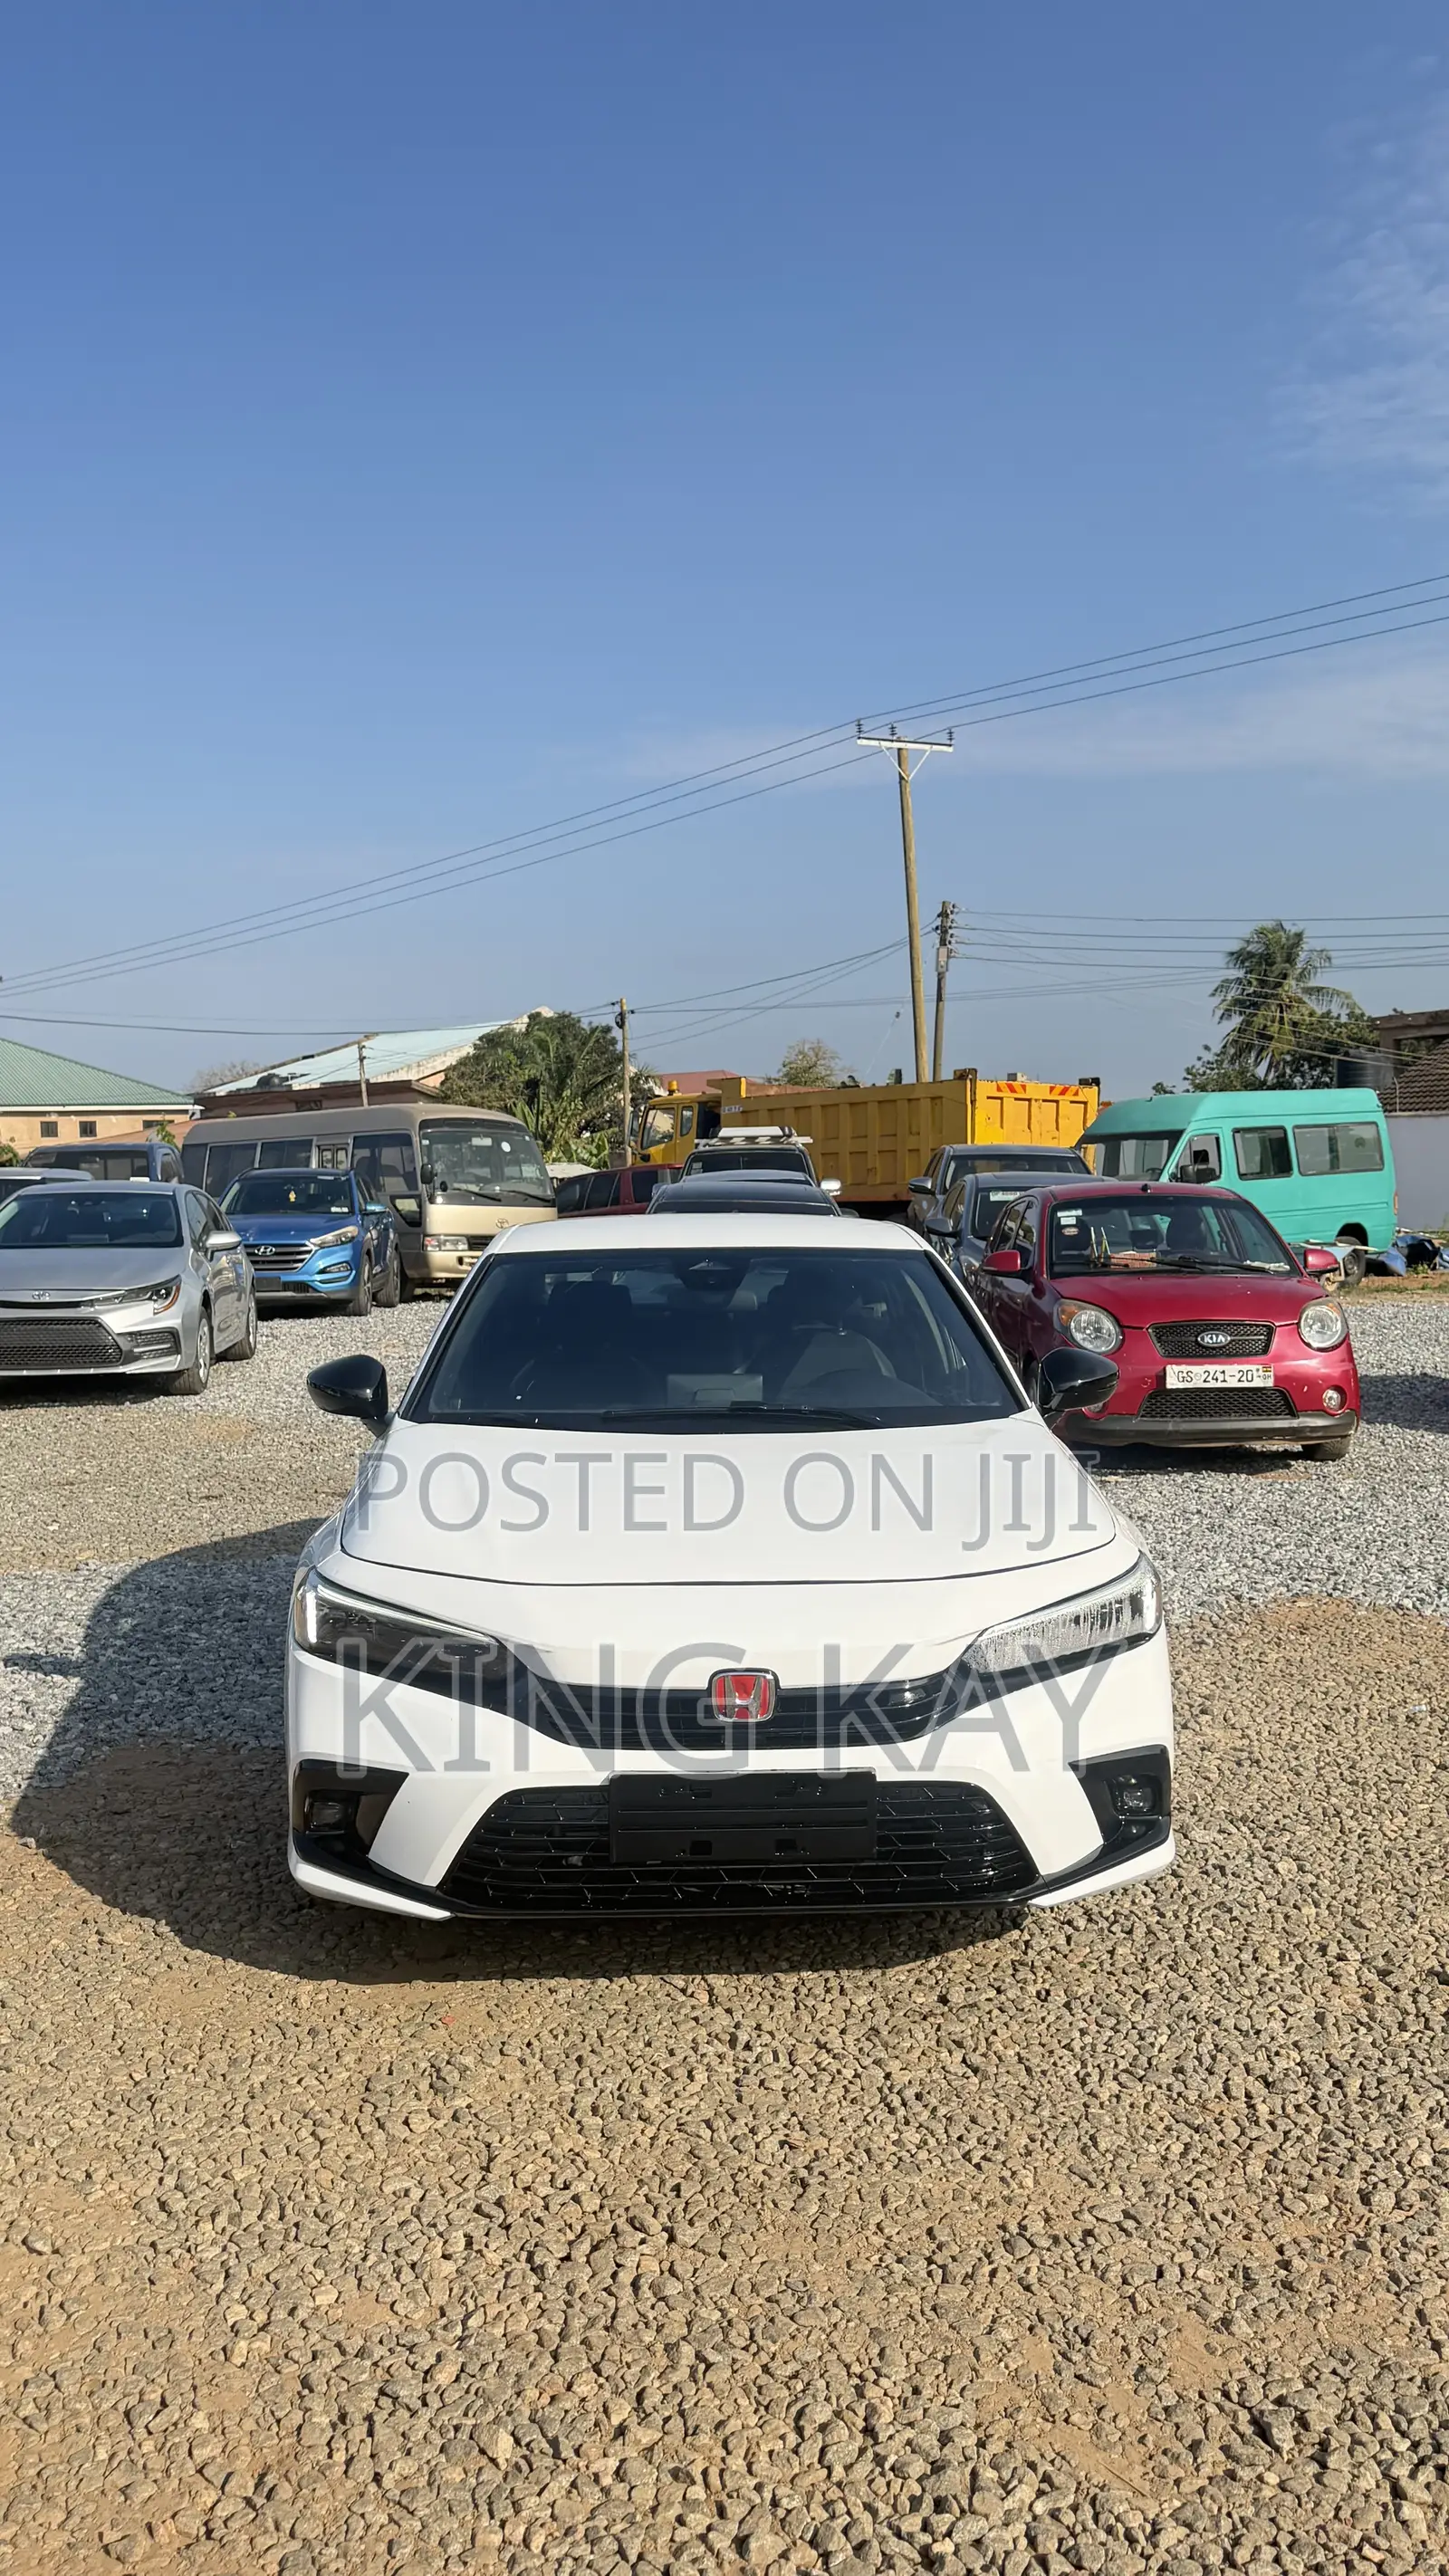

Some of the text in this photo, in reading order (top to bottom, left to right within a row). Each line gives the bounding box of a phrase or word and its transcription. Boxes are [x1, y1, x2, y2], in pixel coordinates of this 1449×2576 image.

[1204, 1334, 1225, 1344] KIA
[1176, 1369, 1254, 1384] GS 241-20
